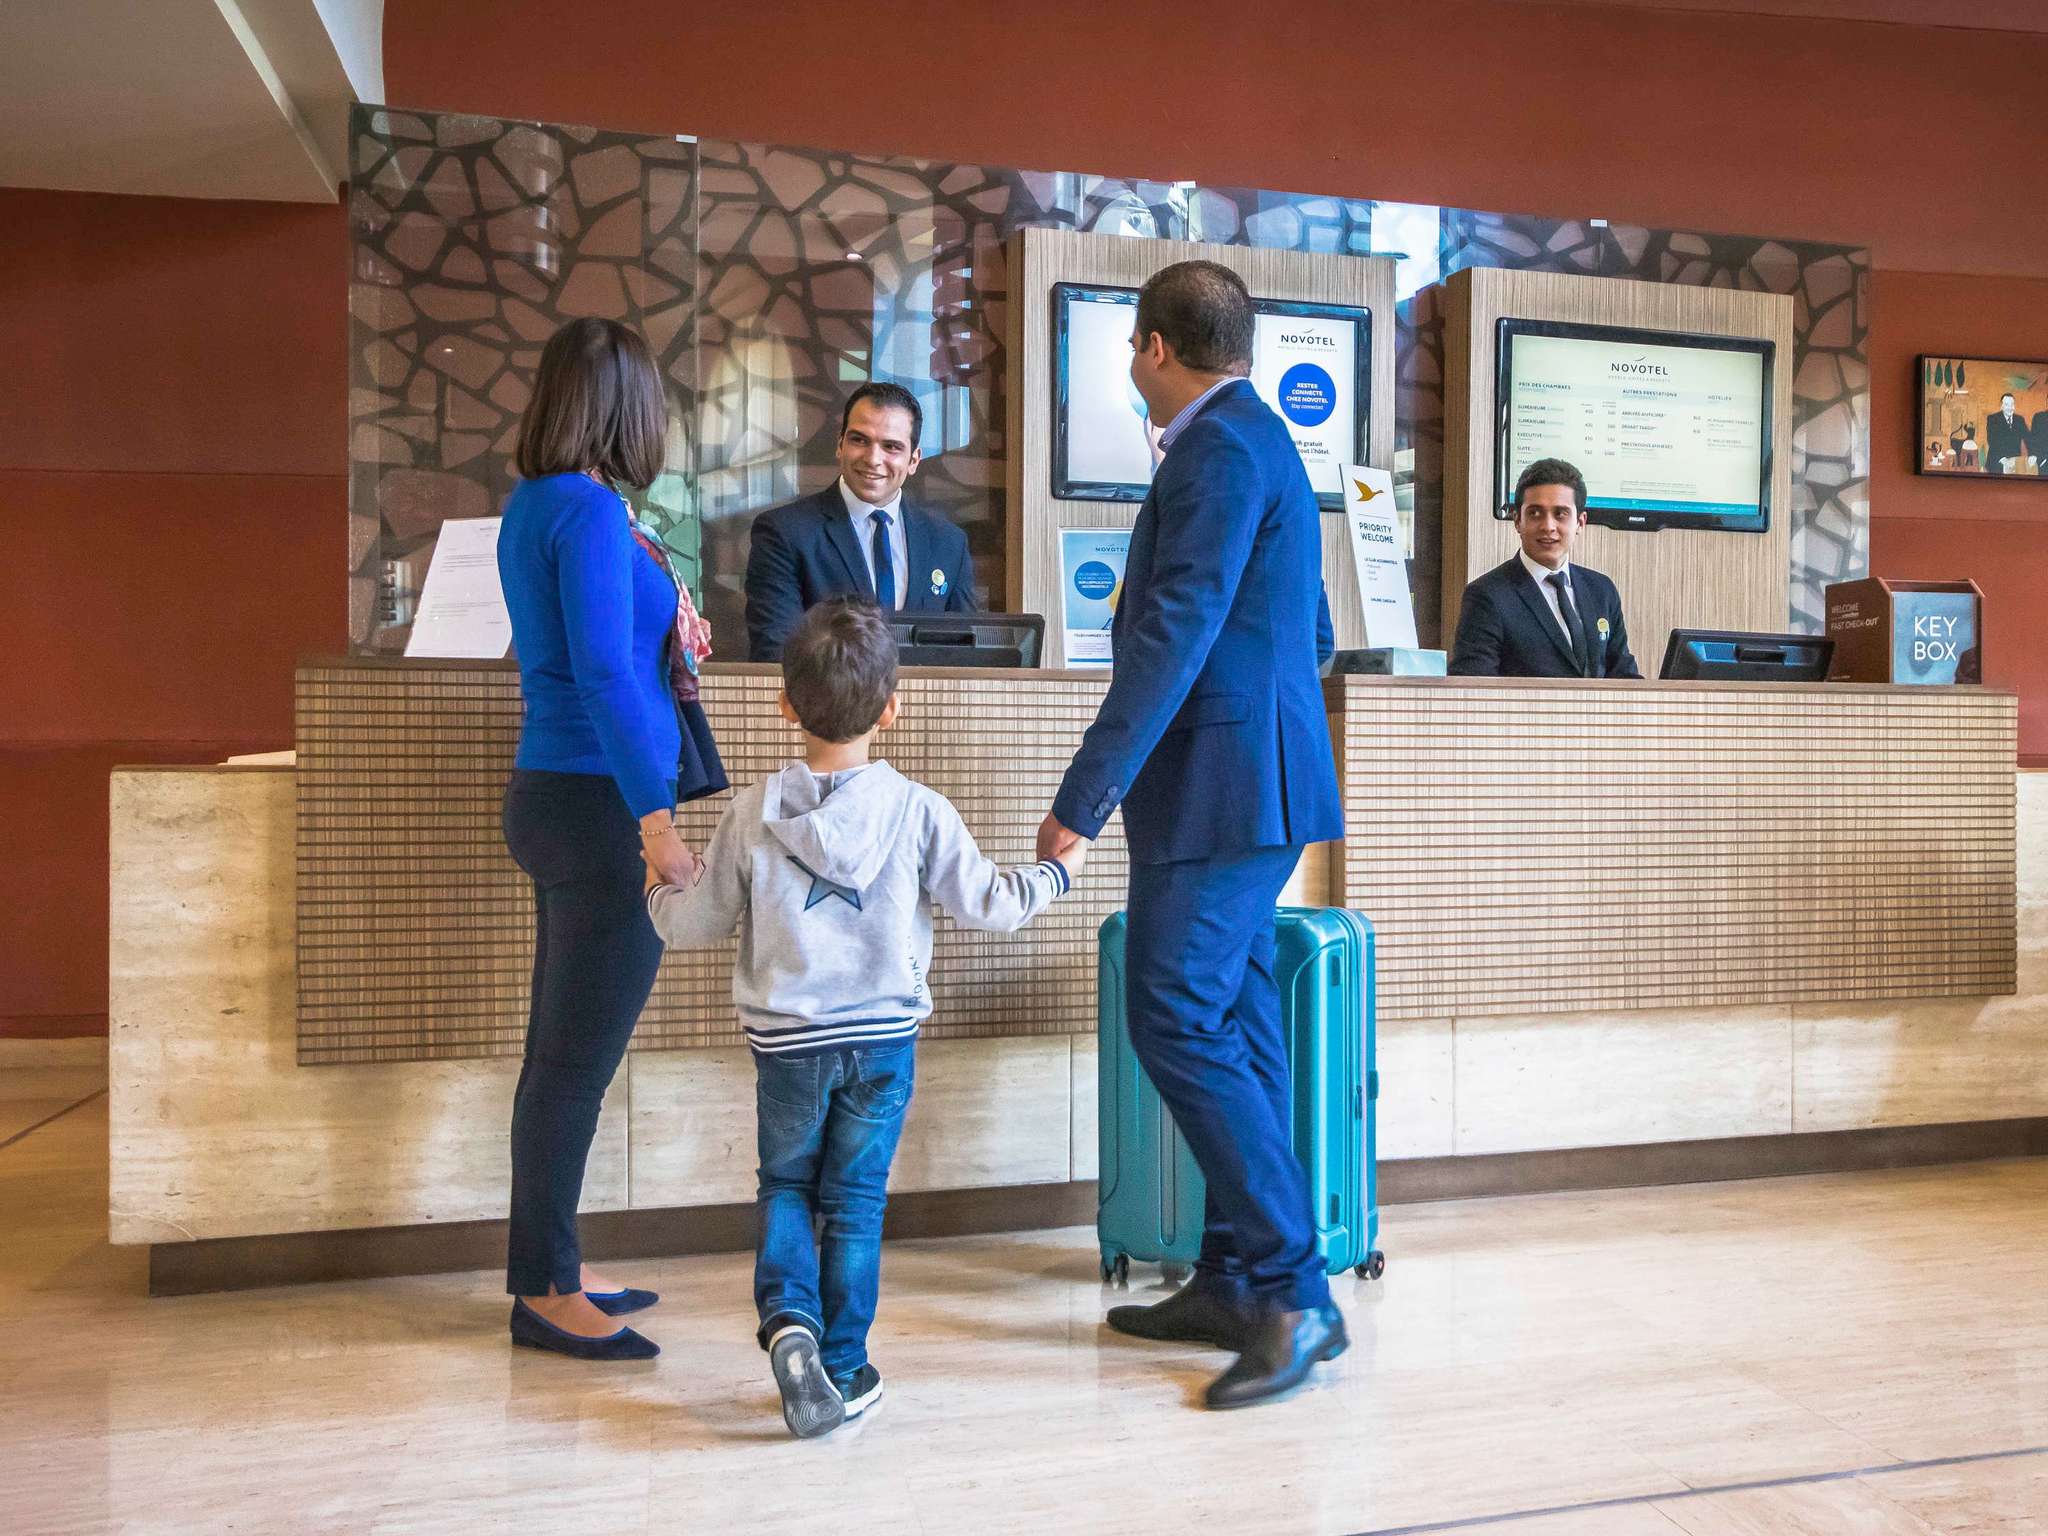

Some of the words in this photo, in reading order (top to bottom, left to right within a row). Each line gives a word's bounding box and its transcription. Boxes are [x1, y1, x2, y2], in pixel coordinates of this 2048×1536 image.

[1281, 334, 1335, 346] NOVOTEL
[1611, 363, 1669, 375] NOVOTEL
[1302, 396, 1328, 404] NOVOTEL
[1359, 521, 1392, 534] PRIORITY
[1360, 532, 1394, 544] WELCOME
[1831, 602, 1859, 614] WELCOME
[1830, 621, 1844, 632] FAST
[1914, 616, 1957, 637] KEY
[1914, 641, 1957, 661] BOX
